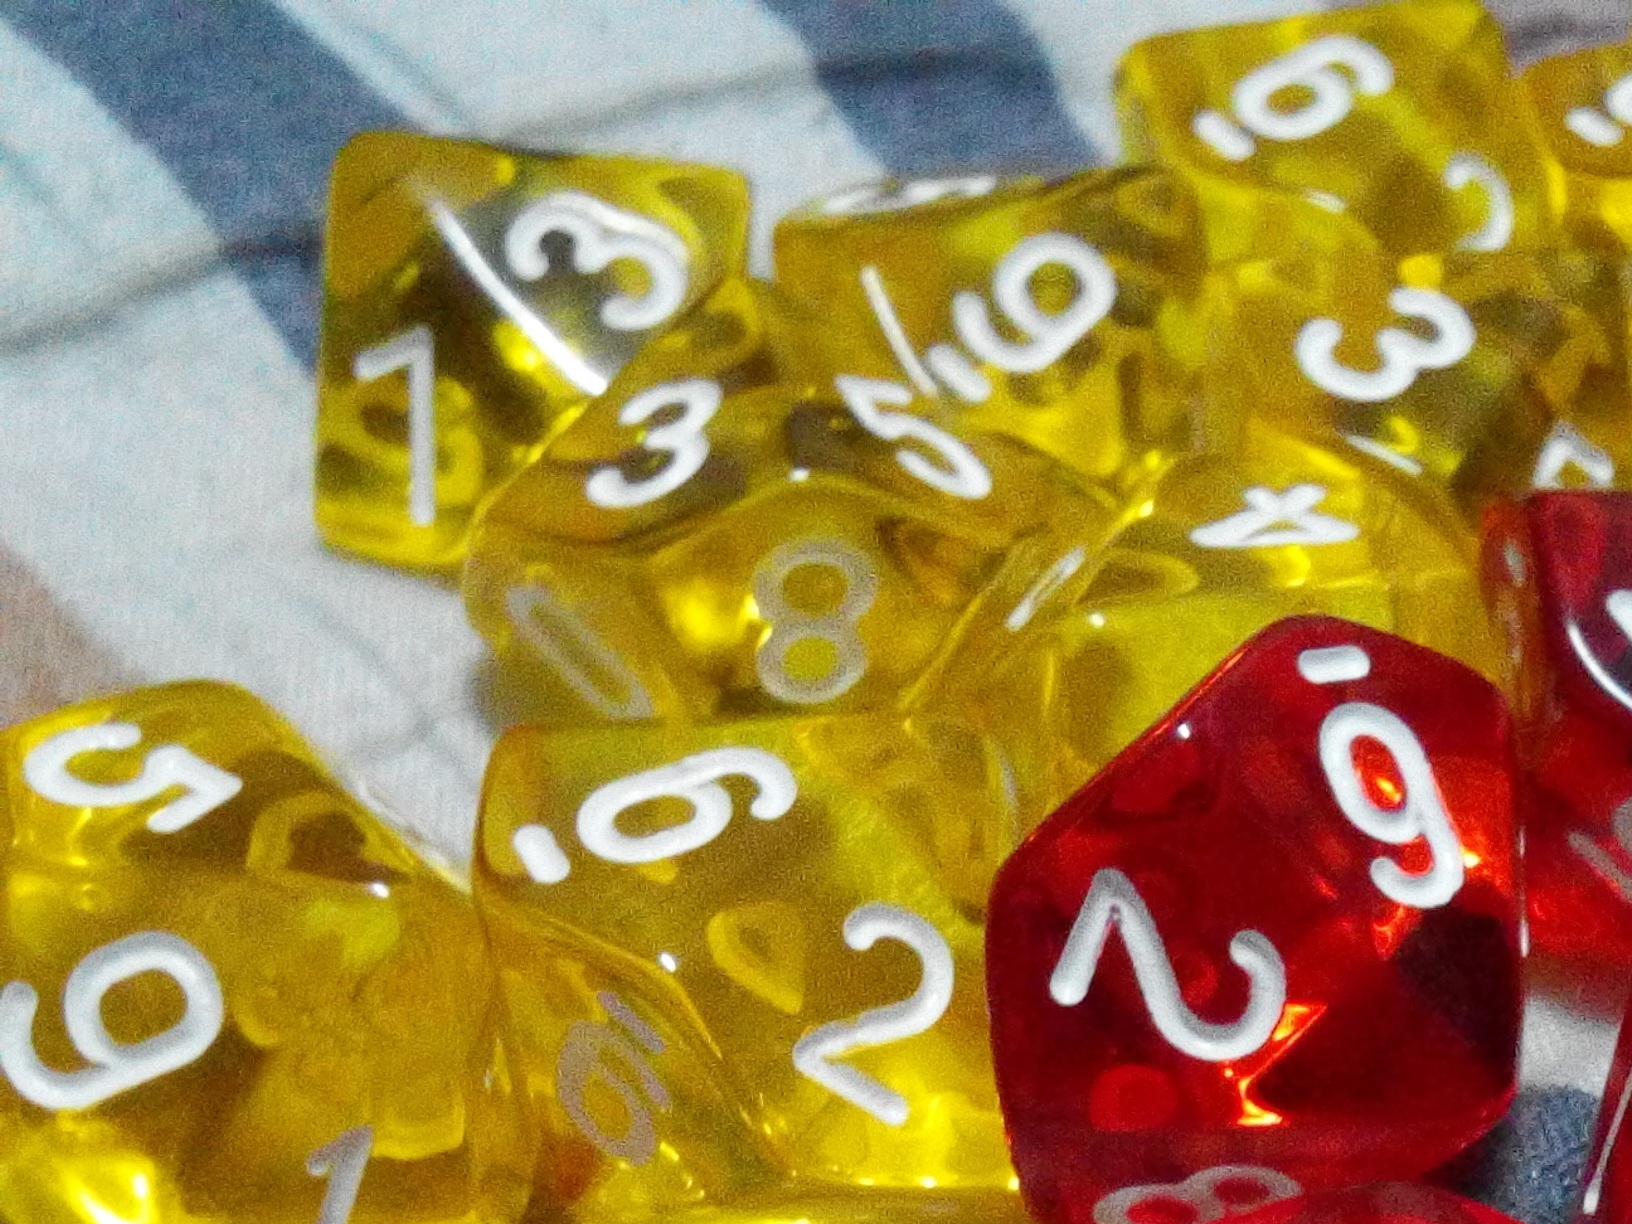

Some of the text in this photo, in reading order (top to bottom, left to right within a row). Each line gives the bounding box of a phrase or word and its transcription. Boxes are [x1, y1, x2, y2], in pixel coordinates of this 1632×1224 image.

[505, 190, 688, 332] 3
[1295, 286, 1476, 402] 3
[584, 378, 722, 508] 3
[834, 374, 994, 502] 5
[1188, 483, 1362, 550] 4
[752, 535, 880, 706] 8
[24, 722, 243, 834] 5
[792, 902, 955, 1127] 2
[1048, 868, 1288, 1062] 2
